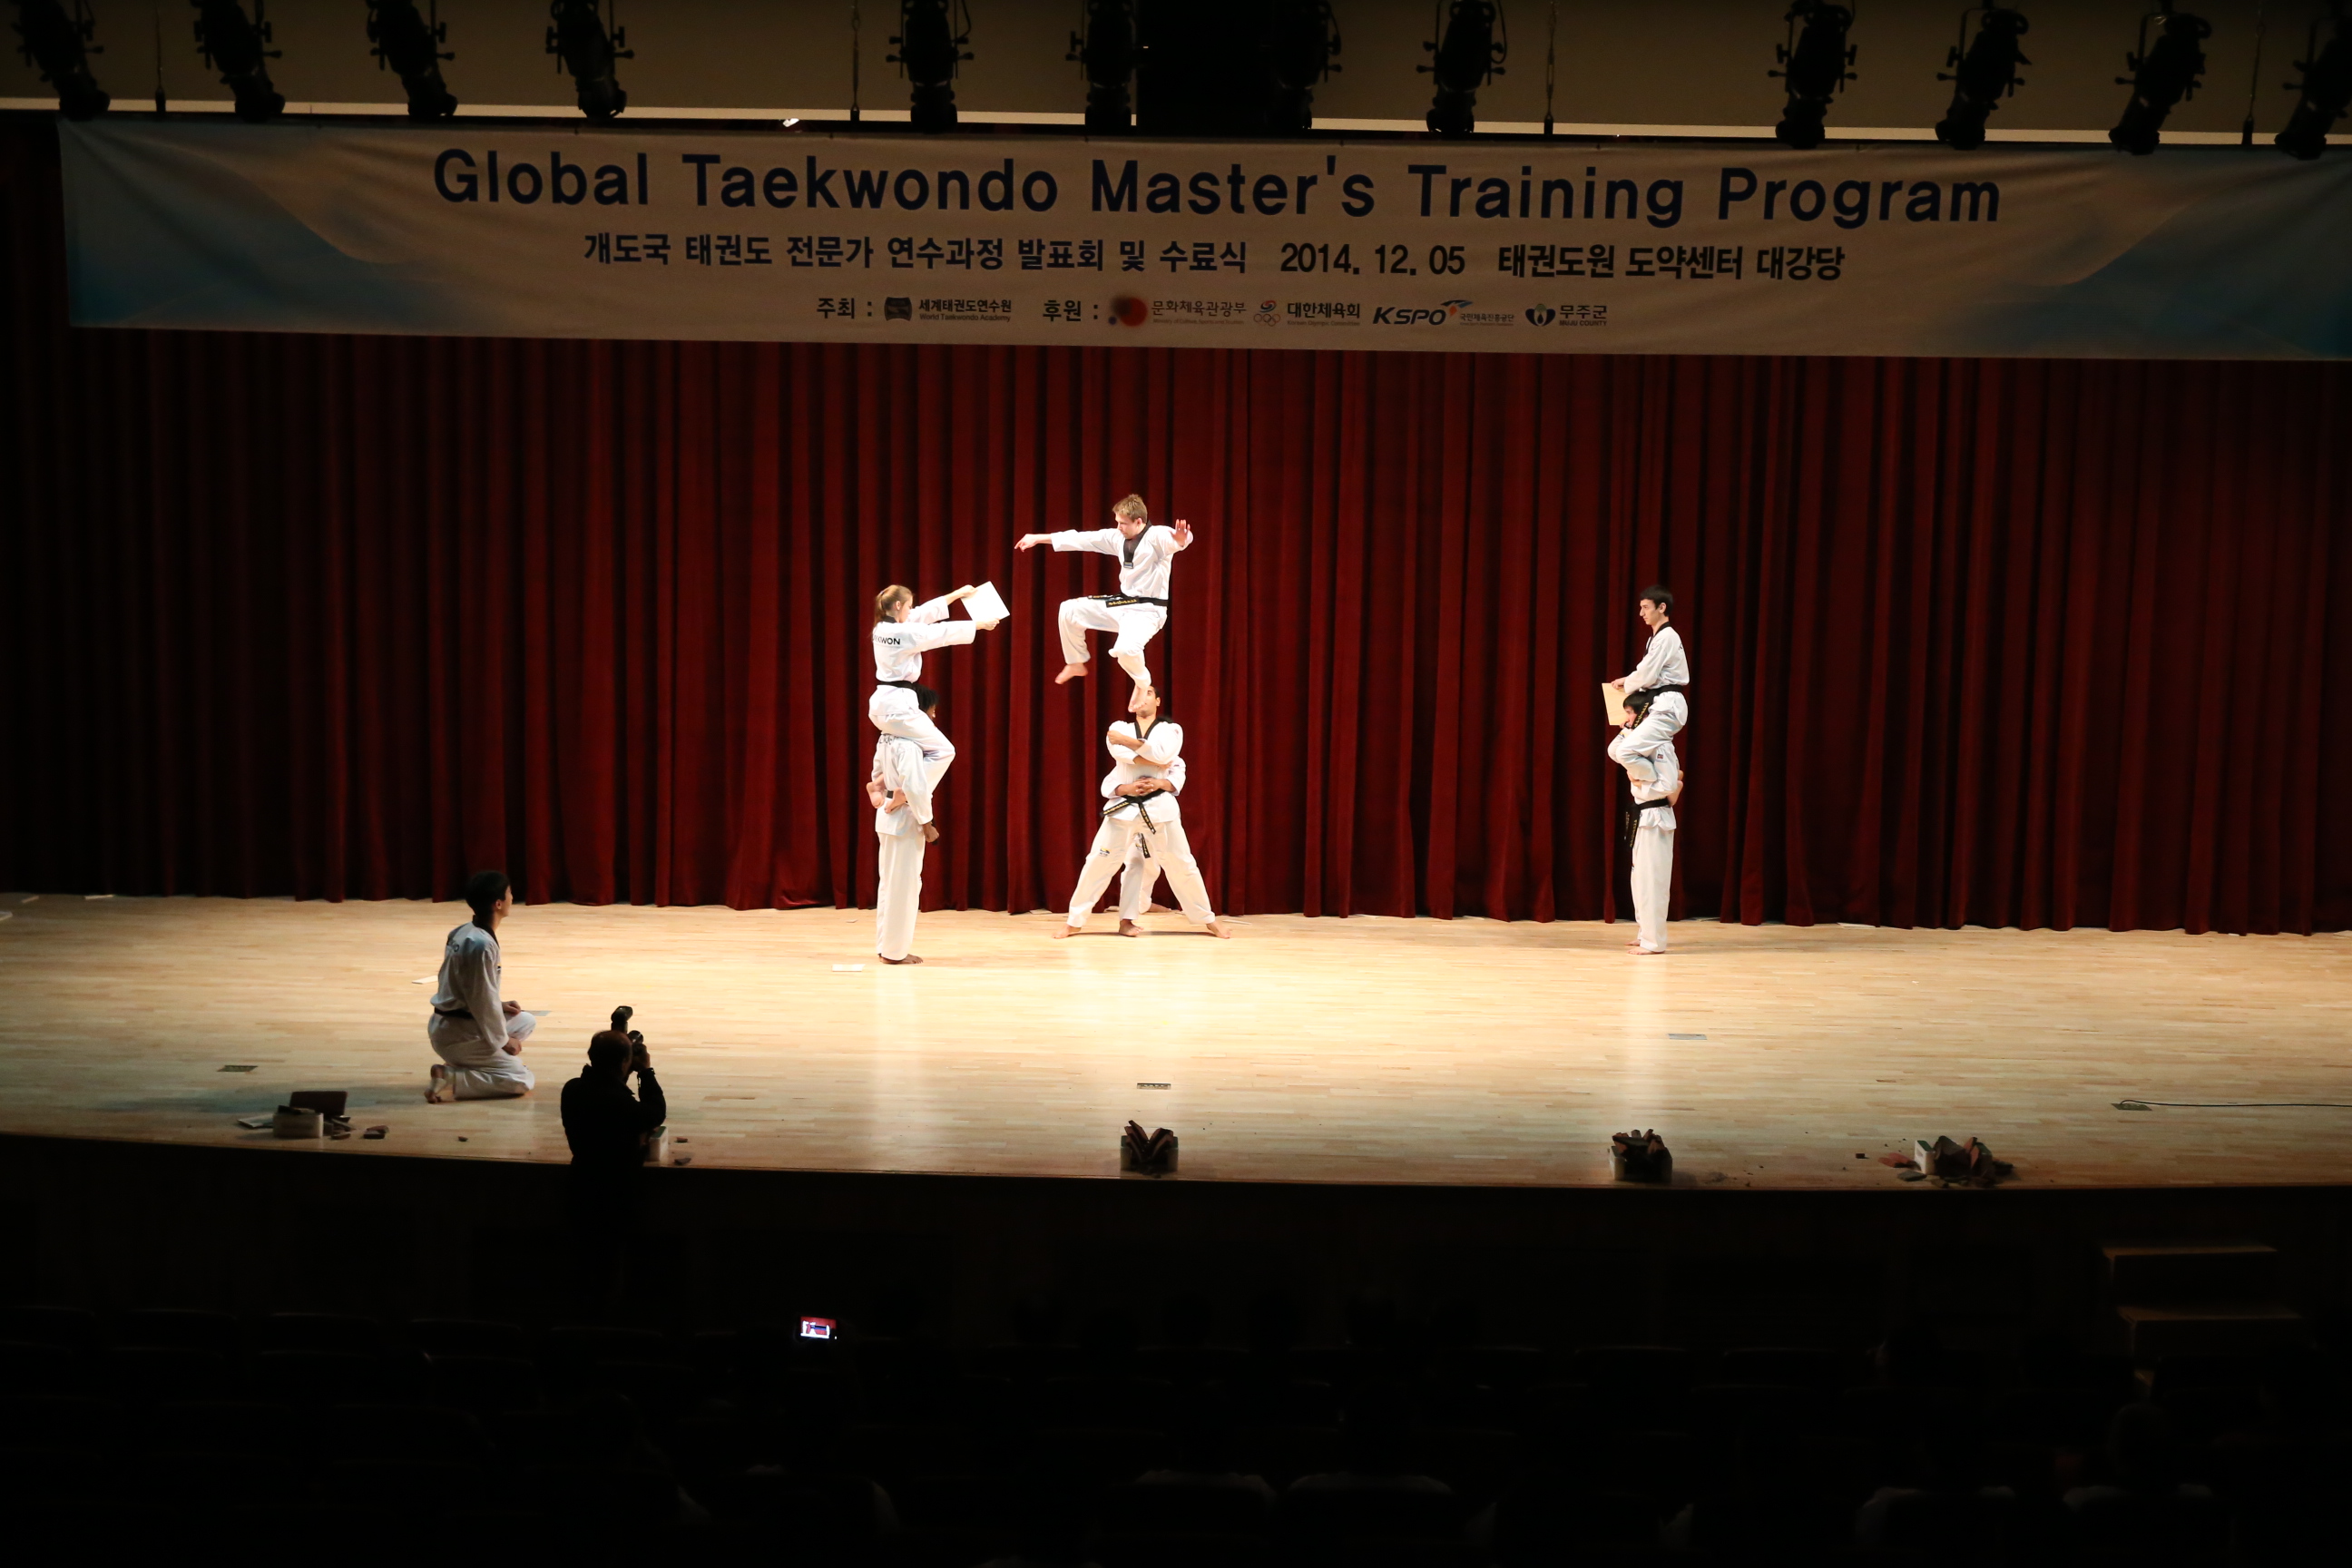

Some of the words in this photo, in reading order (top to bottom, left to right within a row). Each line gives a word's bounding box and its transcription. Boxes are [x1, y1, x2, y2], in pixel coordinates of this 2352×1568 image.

[435, 149, 648, 205] Global
[682, 154, 1057, 211] Taekwondo
[1092, 155, 1374, 217] Master's
[1408, 164, 1683, 228] Training
[1719, 167, 1999, 230] Program
[584, 232, 671, 265] 개도국
[686, 234, 772, 266] 태권도
[787, 236, 874, 269] 전문가
[887, 237, 1003, 270] 연수과정
[1018, 239, 1102, 271] 발표회
[1120, 240, 1144, 271] 및
[1160, 241, 1246, 273] 수료식
[1280, 243, 1359, 275] 2014.
[1376, 245, 1416, 276] 12.
[1429, 245, 1465, 275] 05
[1498, 244, 1614, 278] 태권도원
[1625, 246, 1742, 279] 도약센터
[1757, 247, 1845, 280] 대강당
[817, 298, 855, 318] 주최
[919, 299, 1011, 312] 세계태권도연수원
[1043, 300, 1081, 321] 후원
[1152, 300, 1247, 317] 문화체육관광부
[1288, 302, 1359, 318] 대한체육회
[1560, 305, 1607, 318] 무주군
[1373, 306, 1447, 325] KSPO
